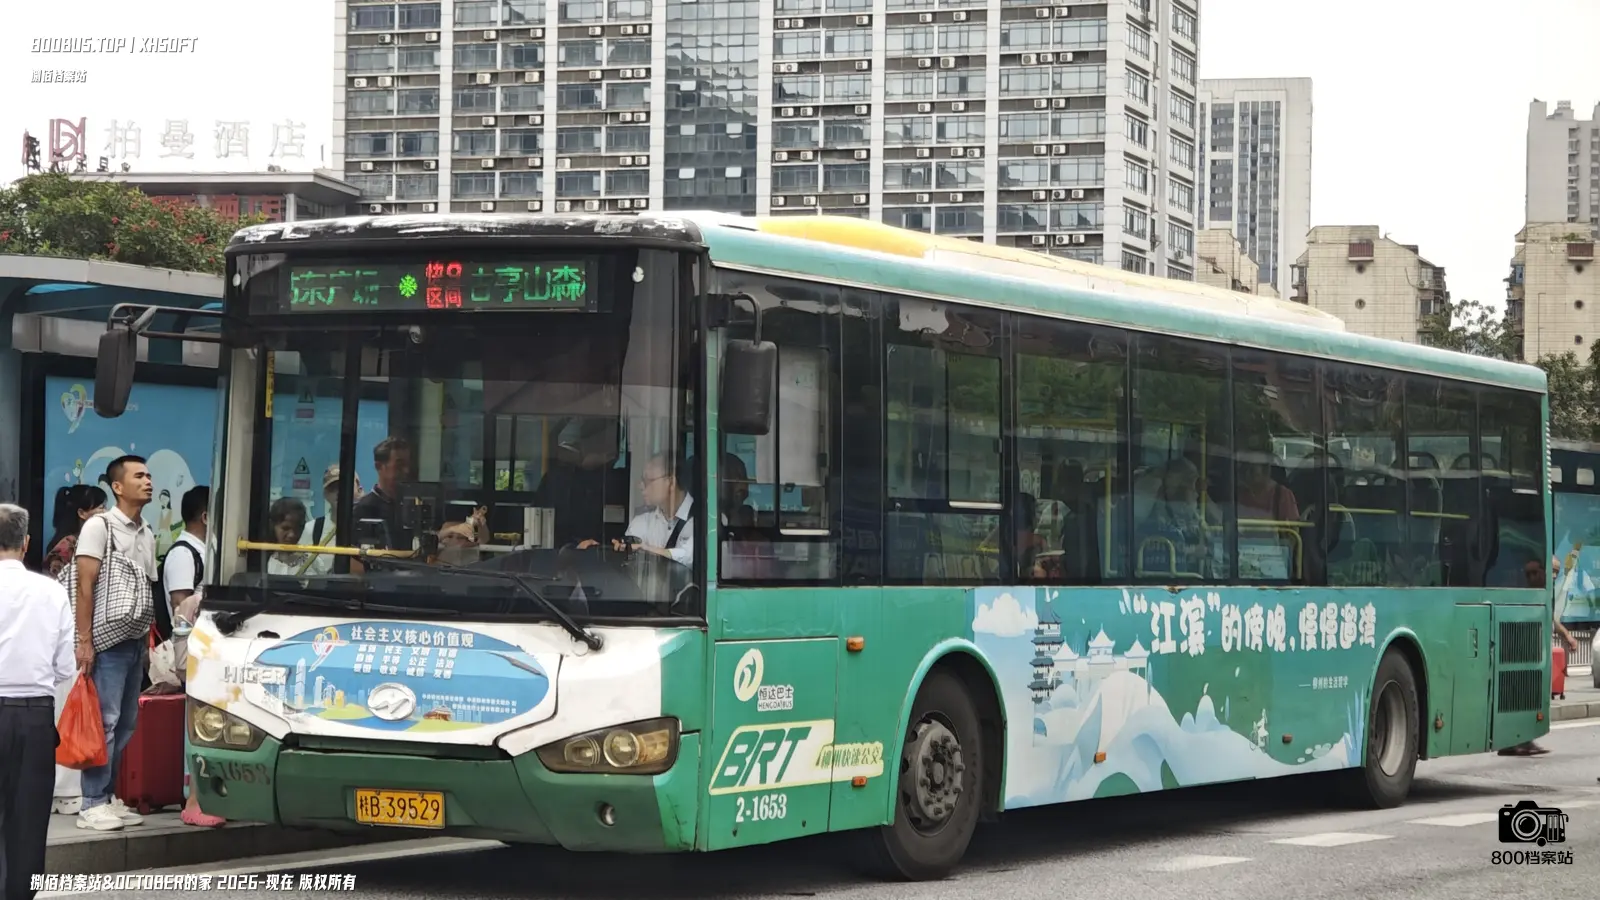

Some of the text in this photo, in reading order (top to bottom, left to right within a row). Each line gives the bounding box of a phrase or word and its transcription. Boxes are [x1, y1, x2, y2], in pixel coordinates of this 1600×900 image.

[103, 117, 306, 160] 柏曼酒店
[425, 286, 463, 309] 区间
[351, 625, 475, 648] 社会主义核心价值观
[759, 687, 793, 700] 恒达巴士
[711, 726, 812, 789] BRT
[735, 793, 788, 823] 2-1653
